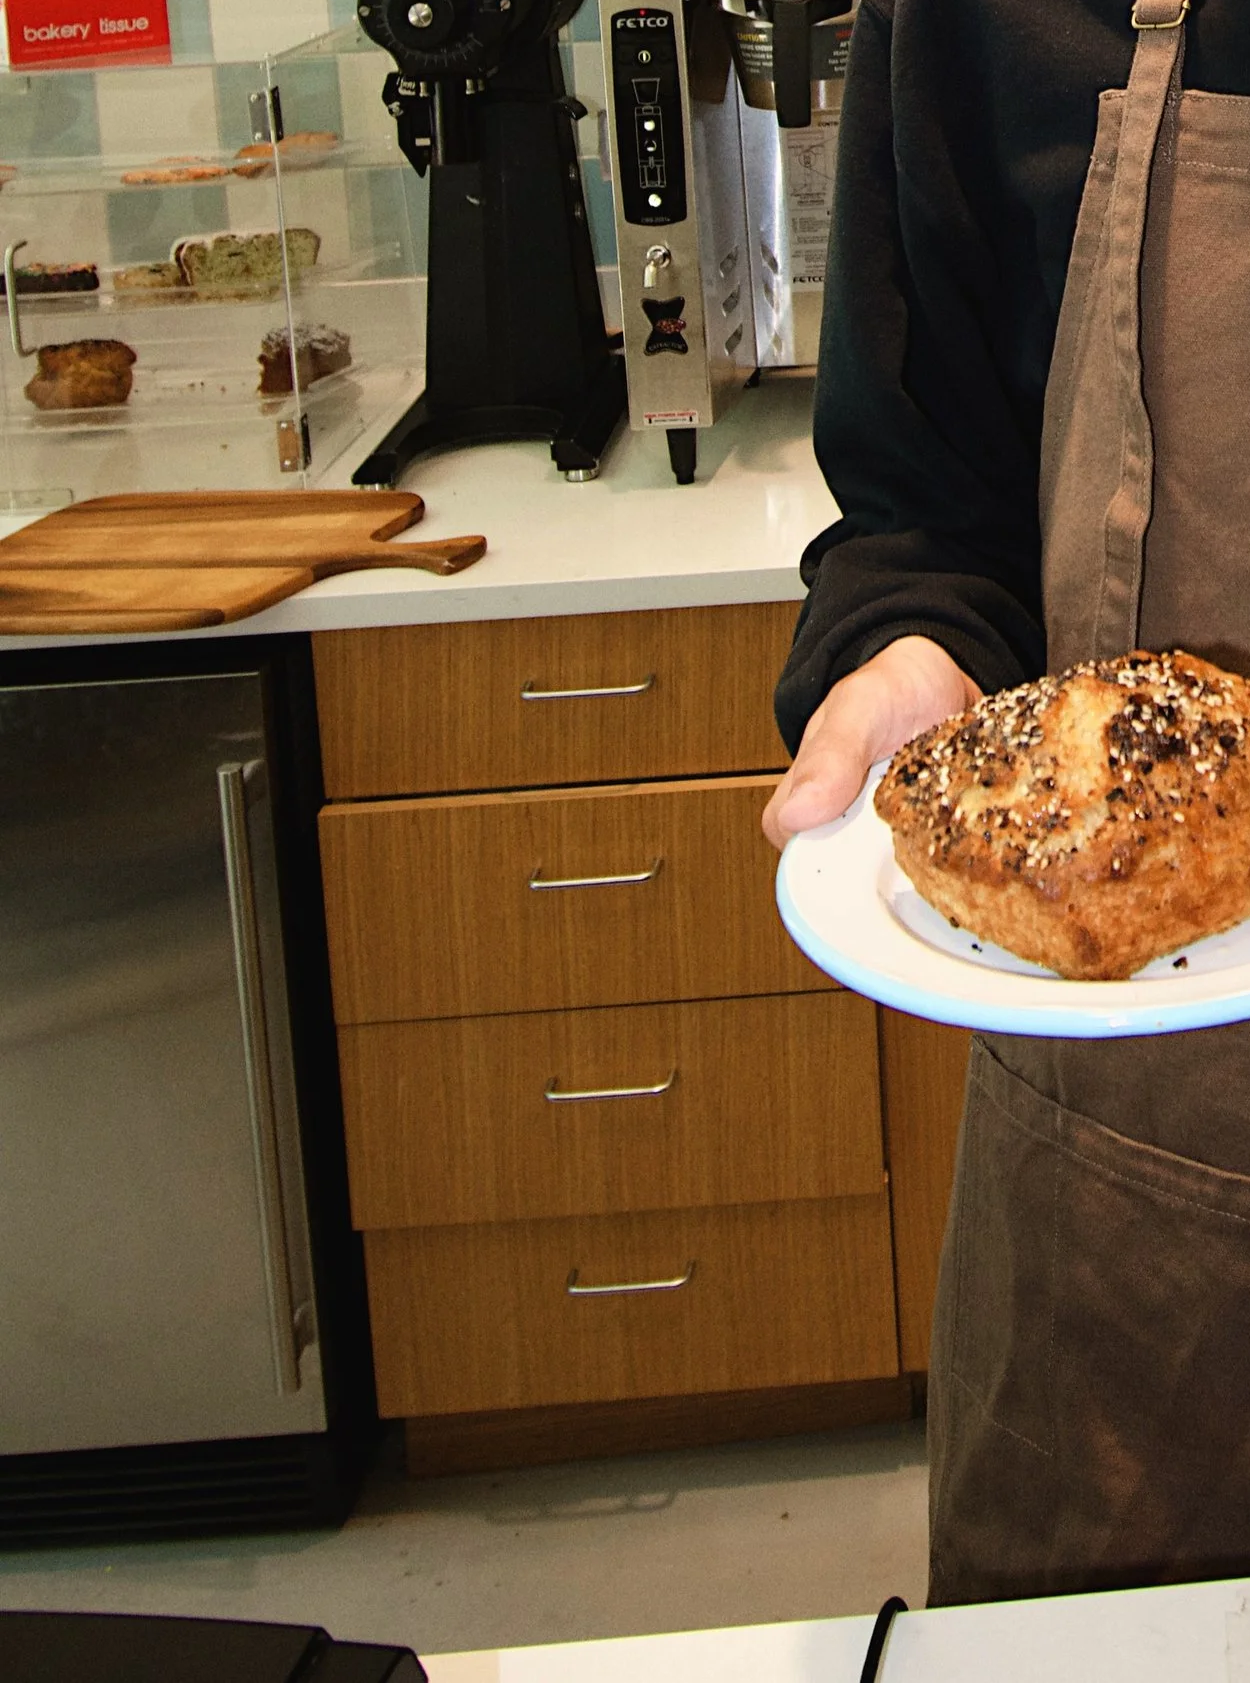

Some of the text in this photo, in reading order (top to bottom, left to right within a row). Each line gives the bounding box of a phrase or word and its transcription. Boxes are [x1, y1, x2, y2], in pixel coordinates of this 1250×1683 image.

[23, 16, 149, 42] bakery tissue
[616, 16, 668, 29] FETCO
